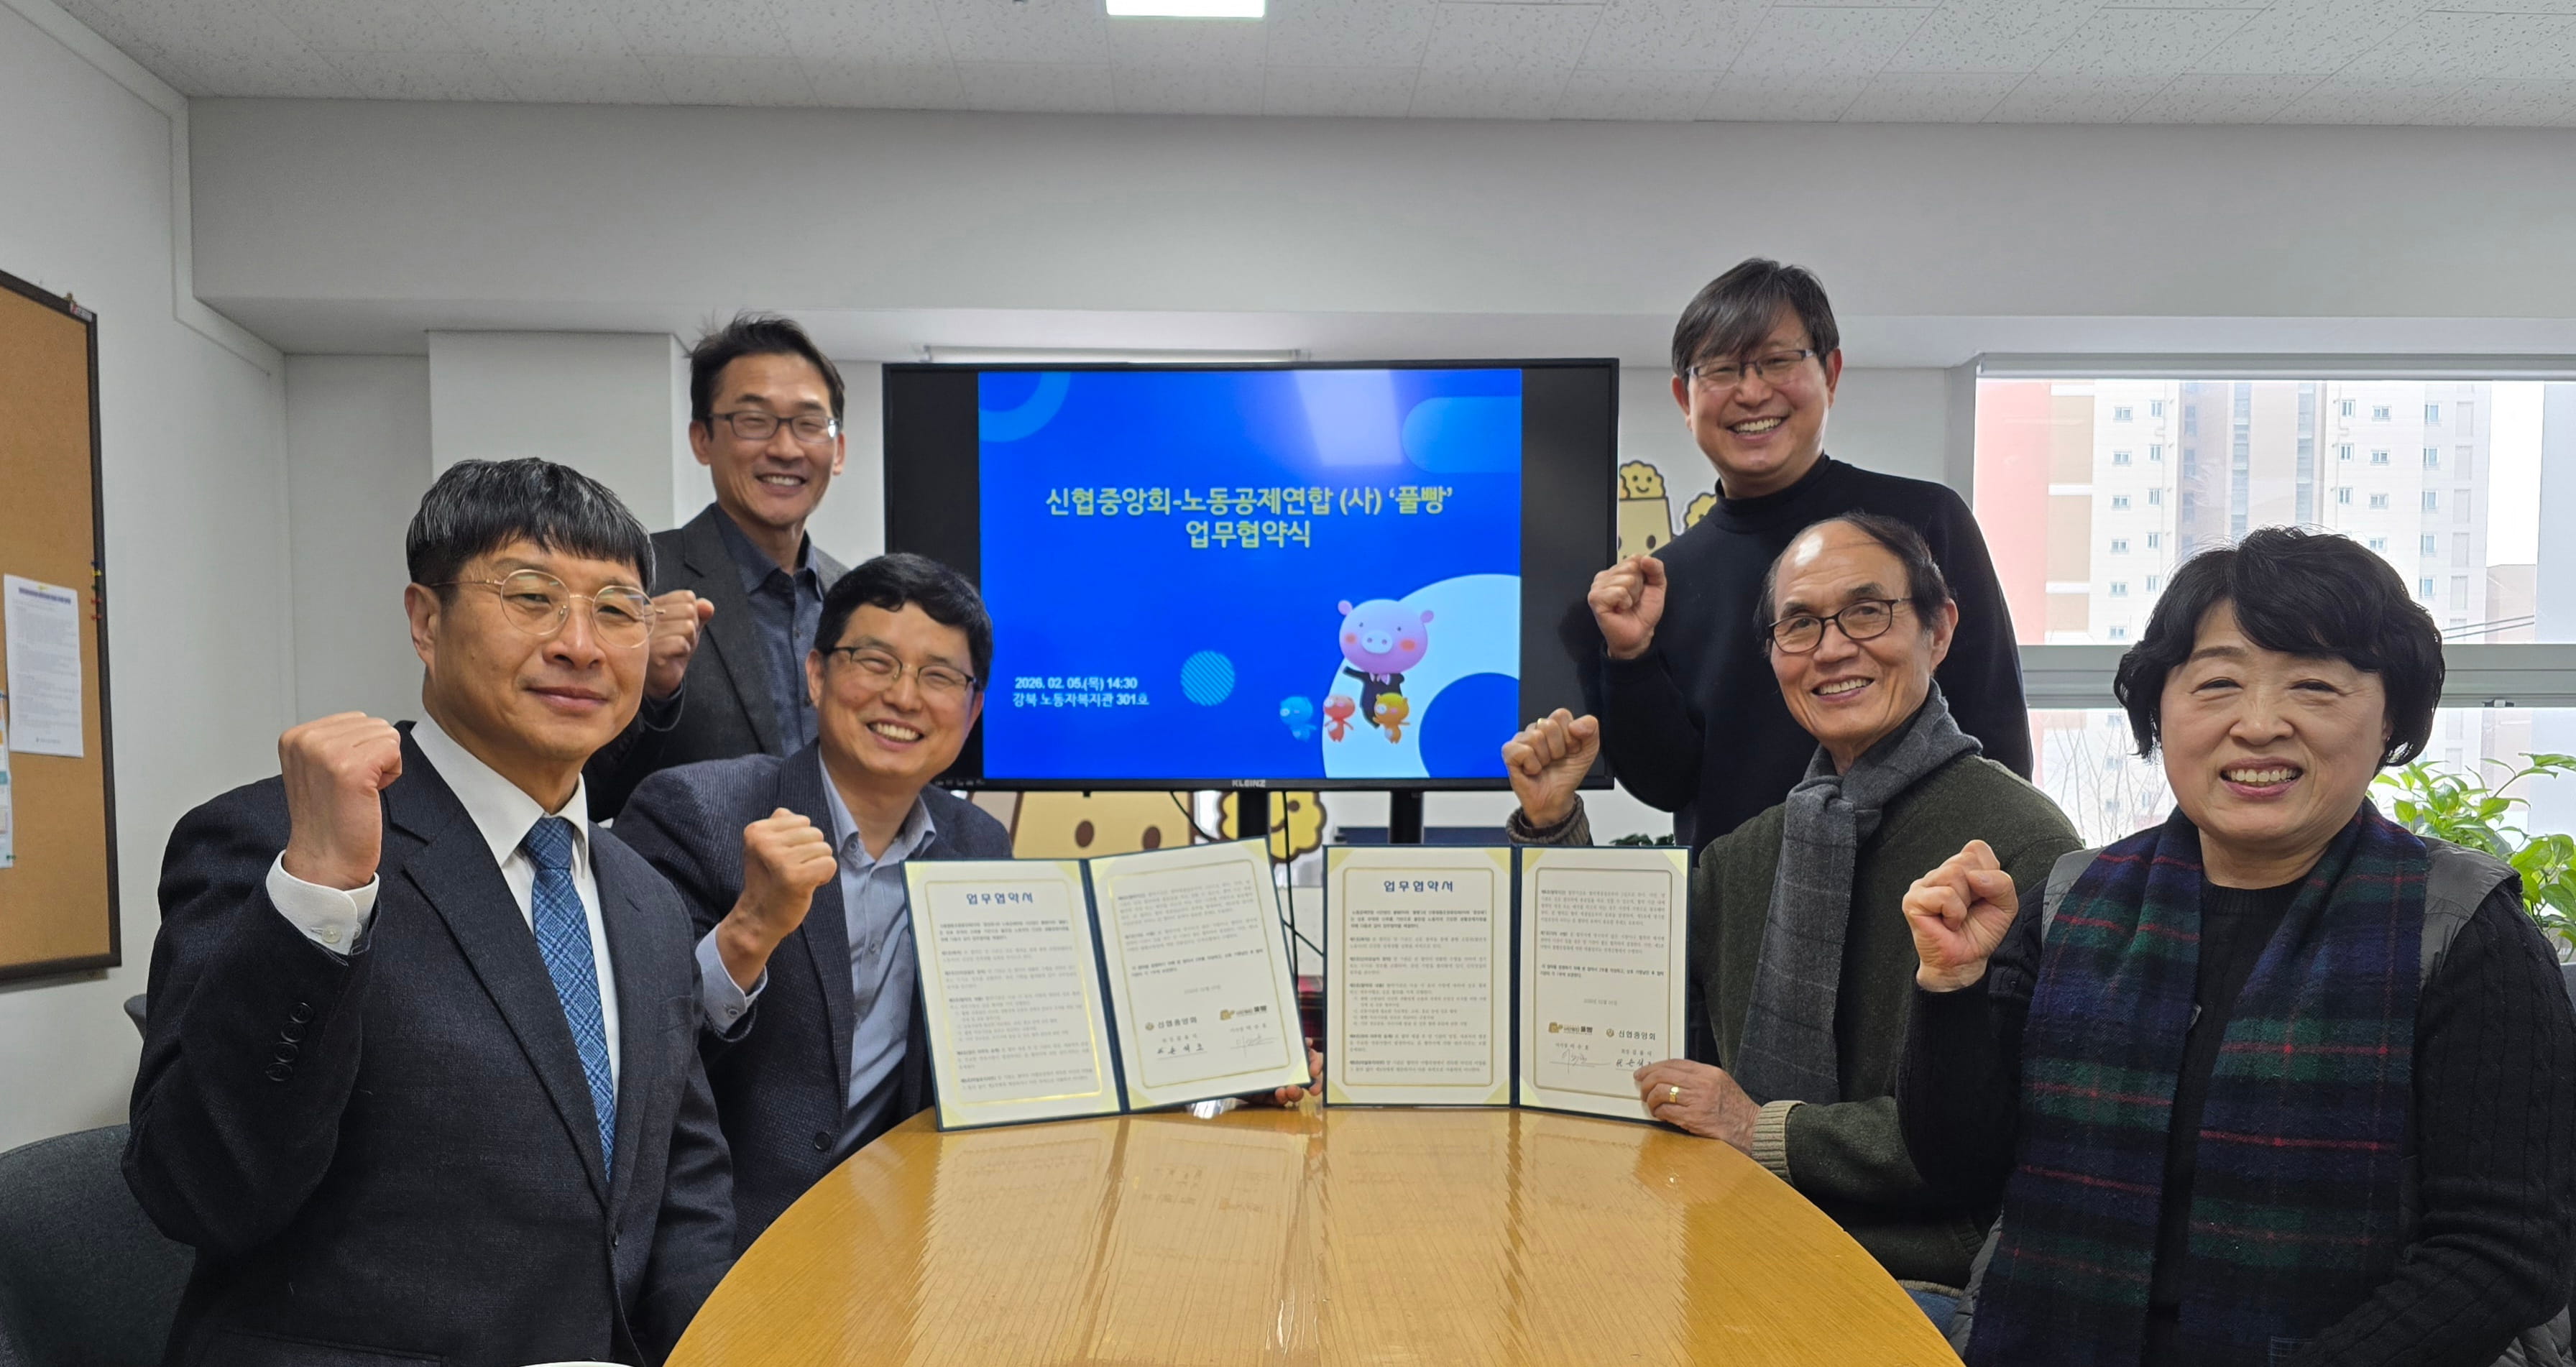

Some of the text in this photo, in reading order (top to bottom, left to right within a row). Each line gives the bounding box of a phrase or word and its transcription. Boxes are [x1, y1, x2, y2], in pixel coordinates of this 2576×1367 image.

[1046, 487, 1333, 515] 신협중앙회-노동공제연합
[1340, 488, 1381, 515] (사)
[1186, 520, 1310, 548] 업무협약식
[1015, 677, 1045, 689] 2026.
[1107, 677, 1138, 689] 14:30
[1013, 693, 1149, 707] 강북 노동자복지관 301호
[1231, 779, 1266, 788] KLEINZ
[1384, 880, 1453, 893] 업무협약서
[966, 893, 1033, 905] 업무협약서
[1618, 1030, 1656, 1041] 신협중앙회
